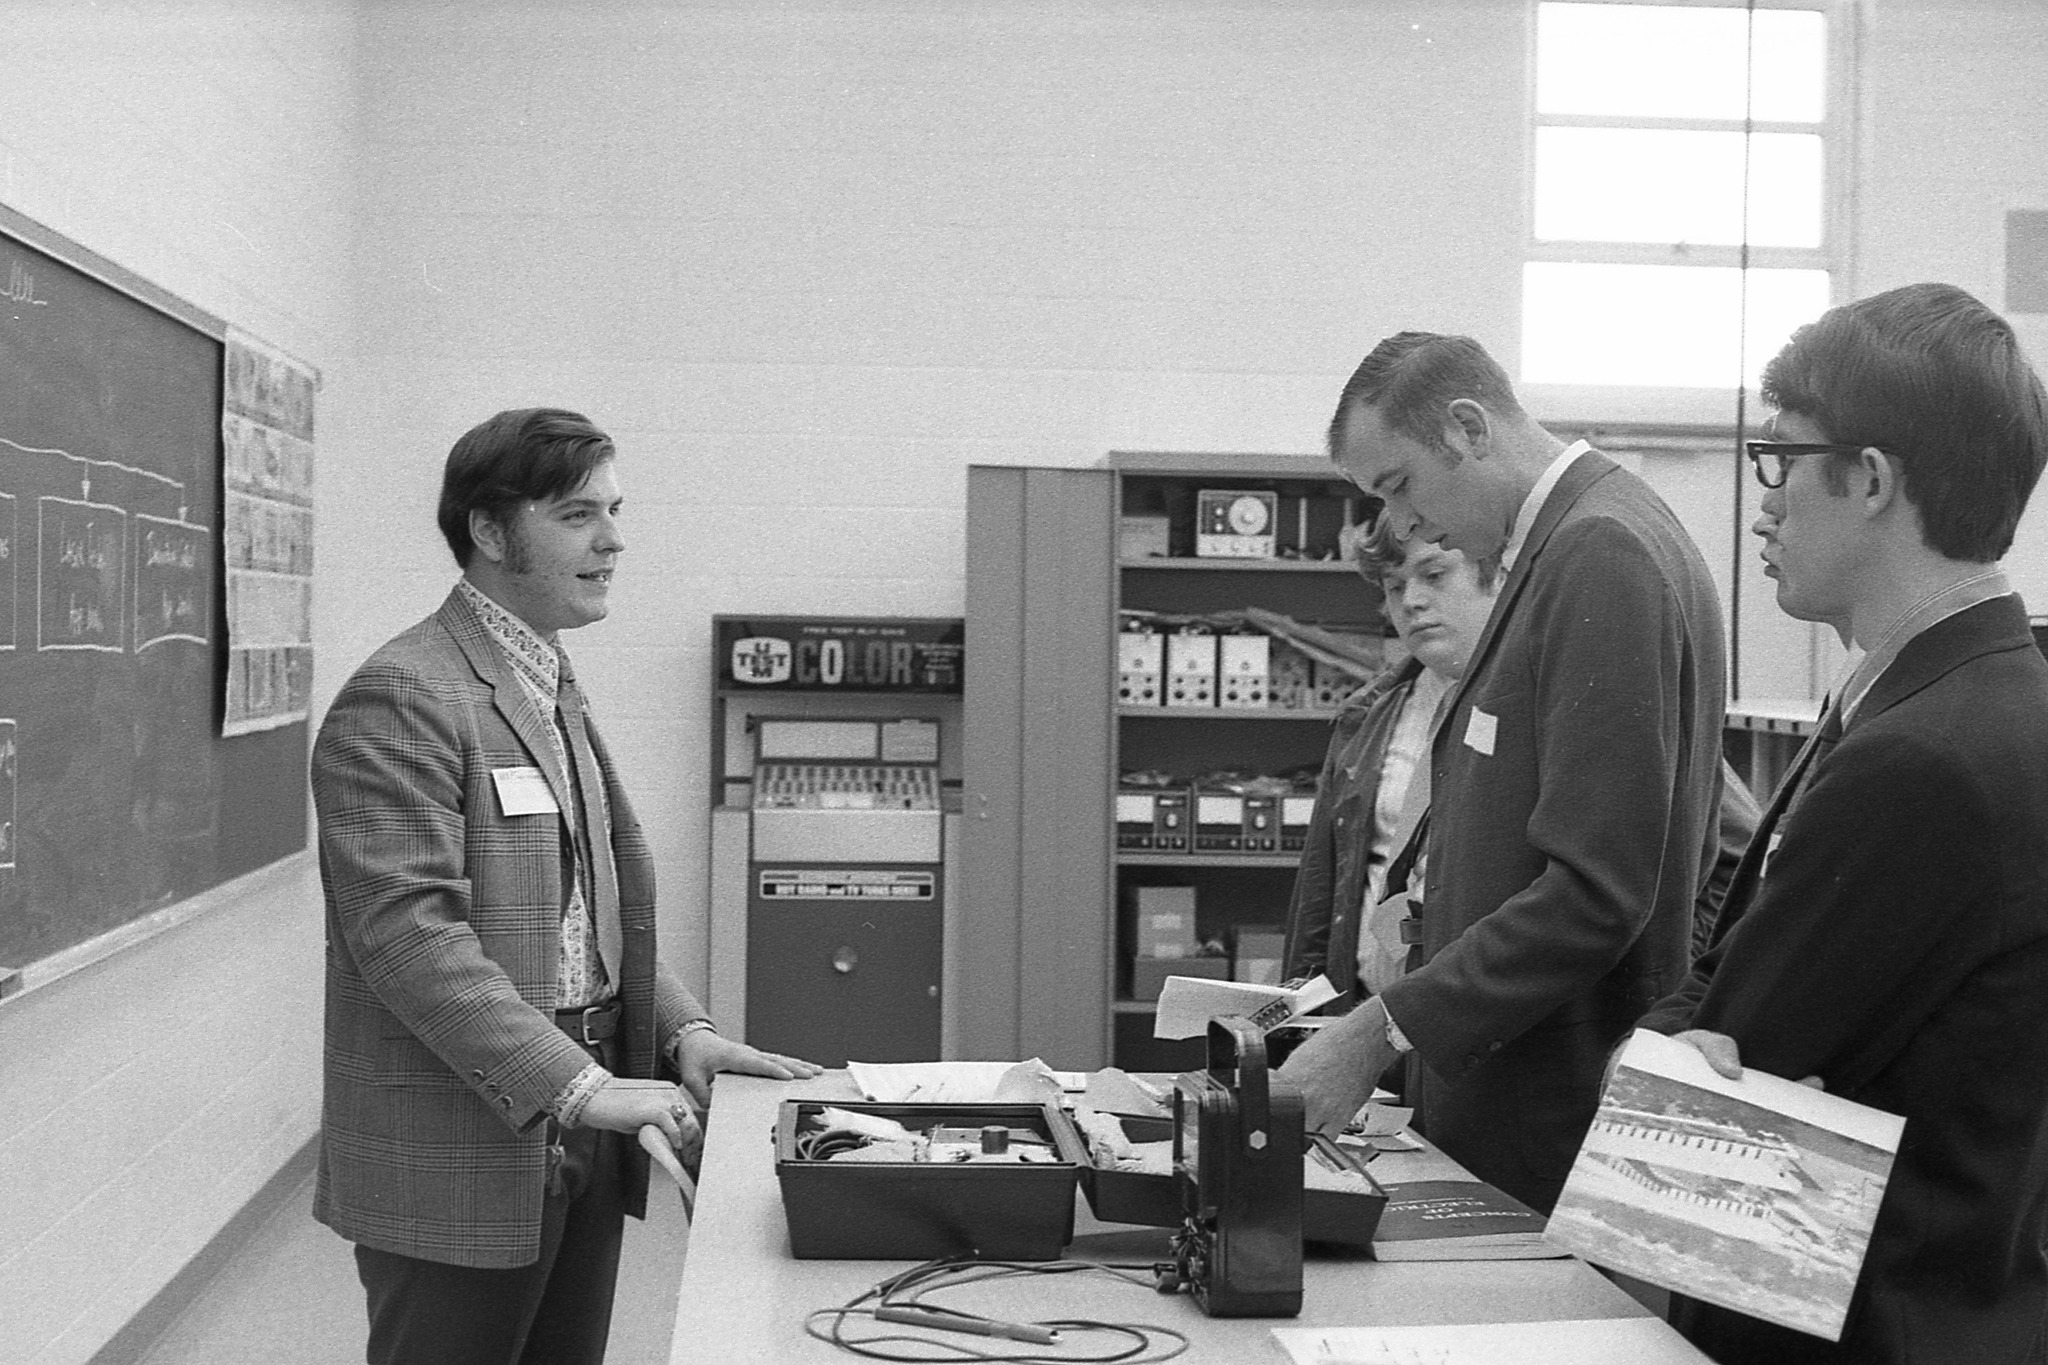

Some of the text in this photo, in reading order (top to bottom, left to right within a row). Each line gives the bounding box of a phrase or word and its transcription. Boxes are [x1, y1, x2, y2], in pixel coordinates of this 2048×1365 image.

[737, 653, 788, 667] TEST
[796, 639, 912, 684] COLOR
[1421, 1211, 1531, 1220] CONCEPTS
